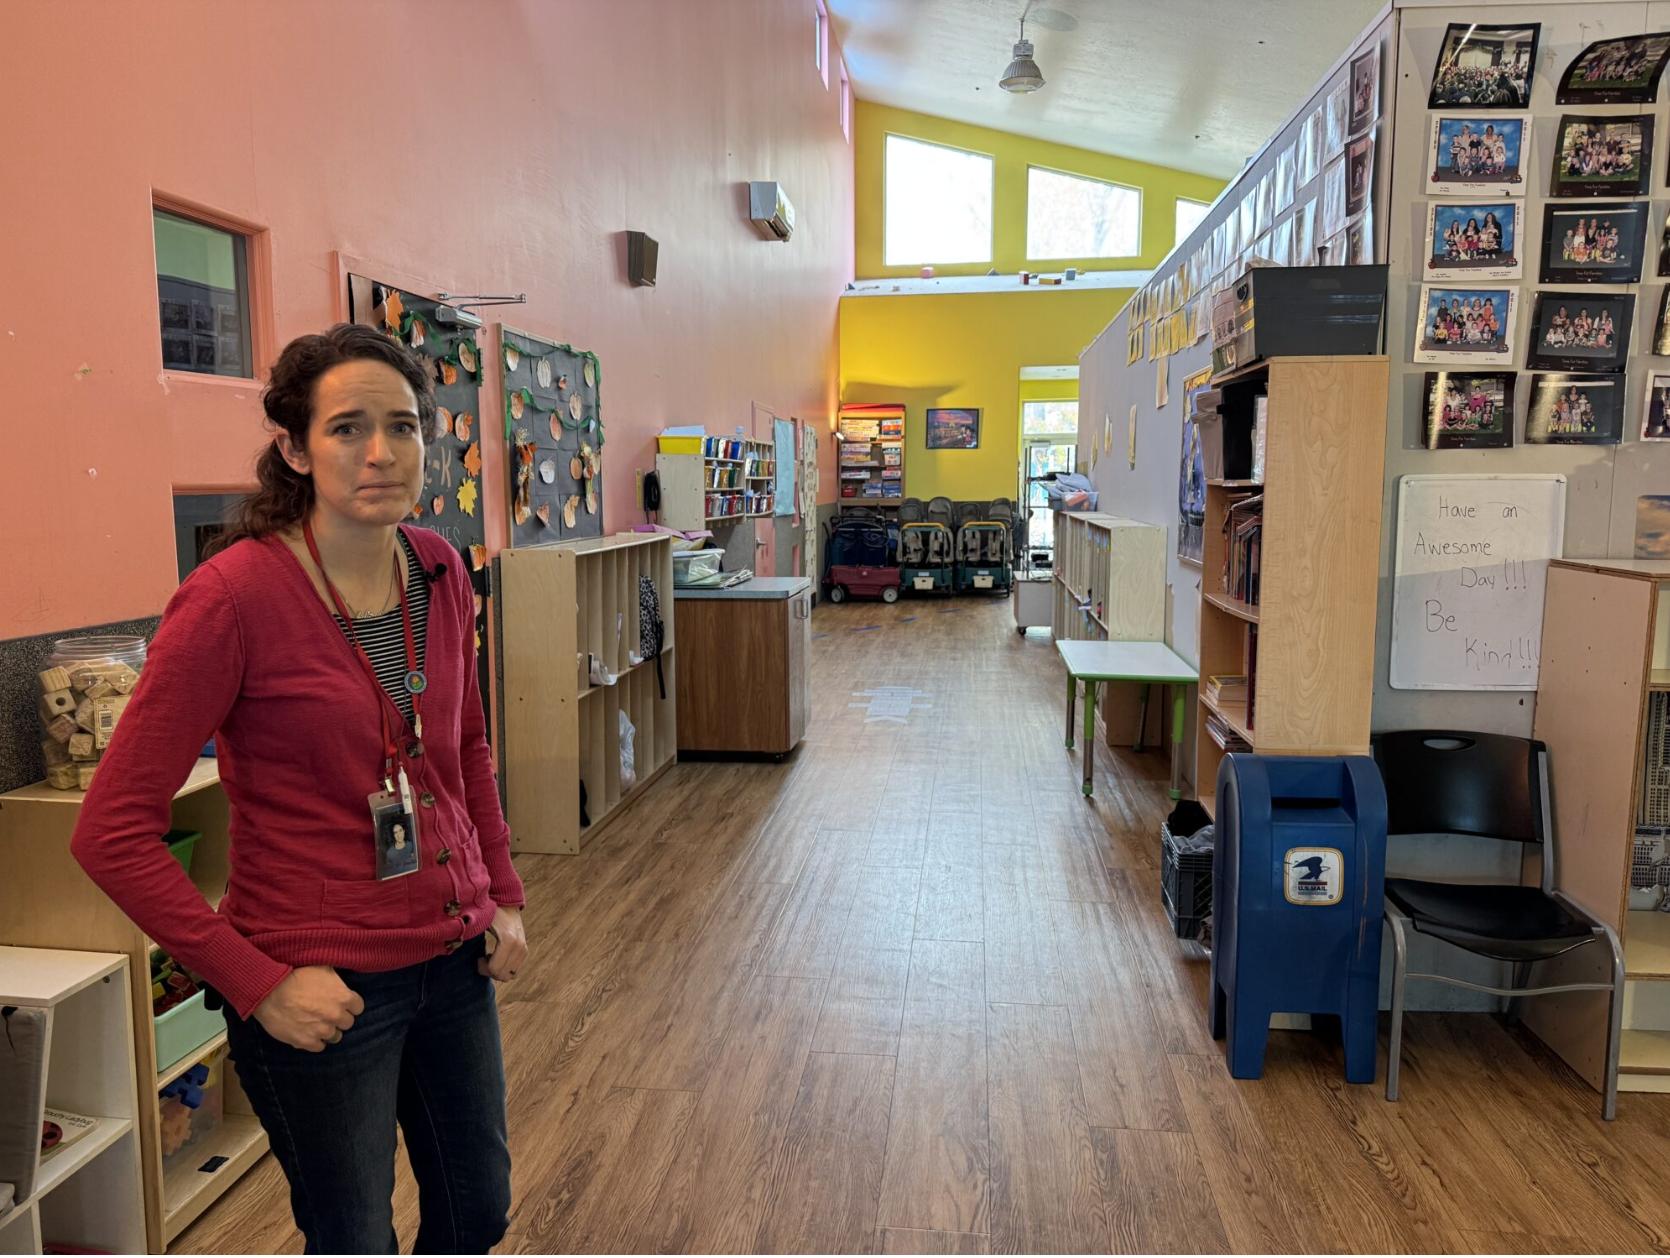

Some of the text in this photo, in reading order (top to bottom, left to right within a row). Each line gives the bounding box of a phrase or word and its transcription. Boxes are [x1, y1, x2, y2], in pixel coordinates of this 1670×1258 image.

[1439, 495, 1518, 518] Have an
[1413, 532, 1492, 556] Awesome
[1425, 599, 1458, 632] Be
